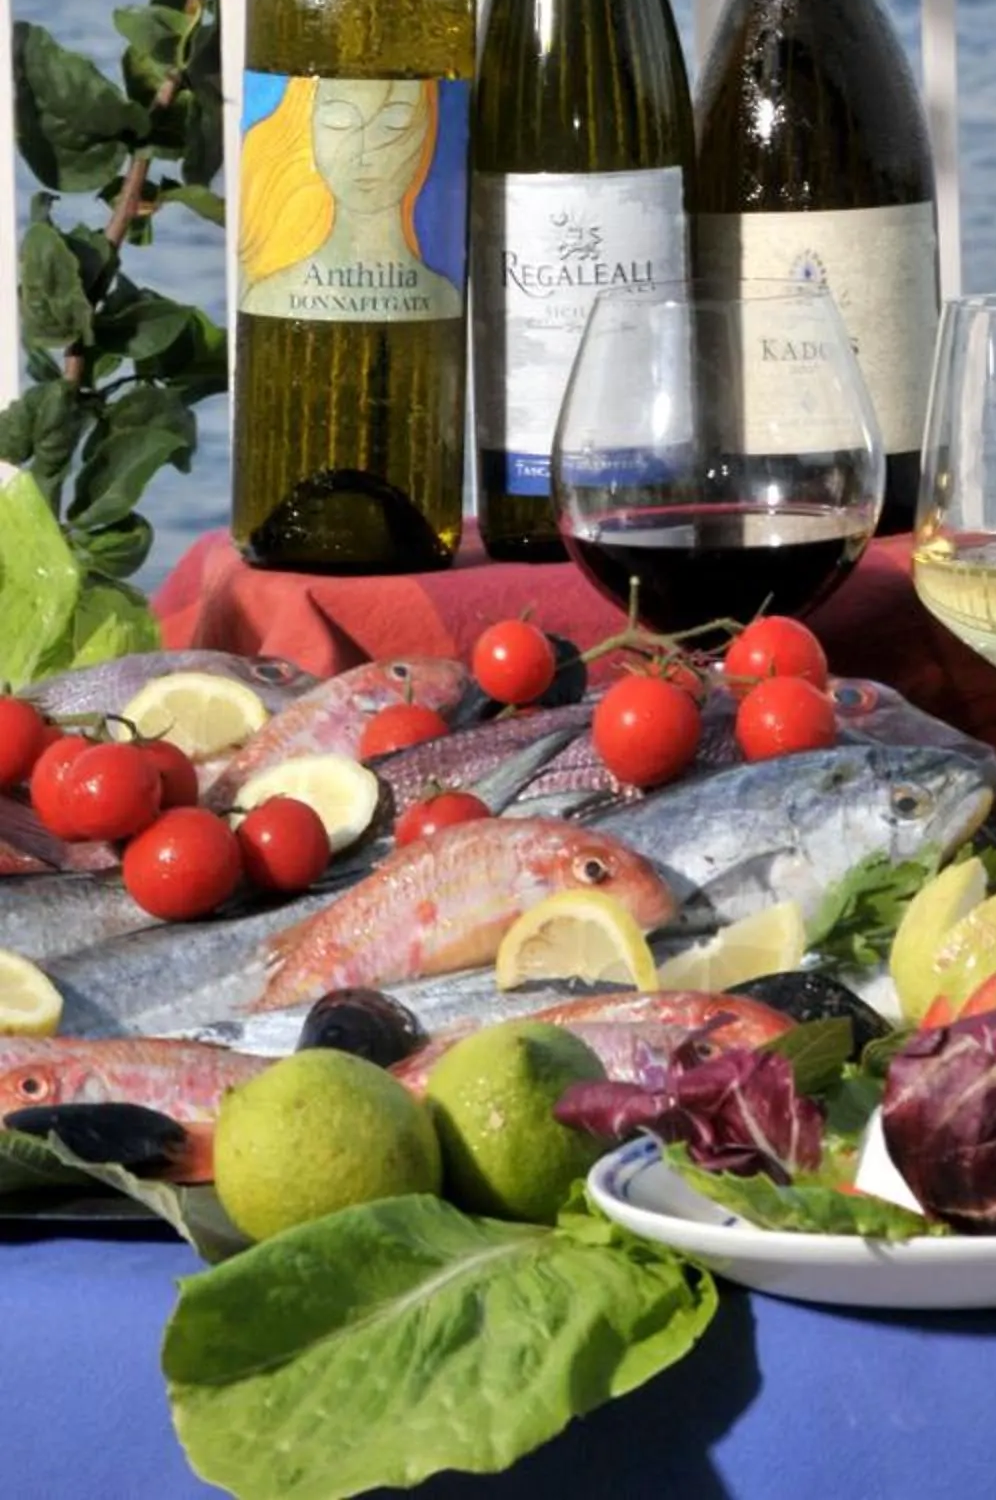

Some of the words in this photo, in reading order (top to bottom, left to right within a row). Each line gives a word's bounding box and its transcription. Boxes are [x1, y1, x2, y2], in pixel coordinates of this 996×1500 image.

[303, 260, 419, 288] Anthilia
[501, 251, 654, 298] REGALEALI
[289, 293, 431, 312] DONNAFUGATA
